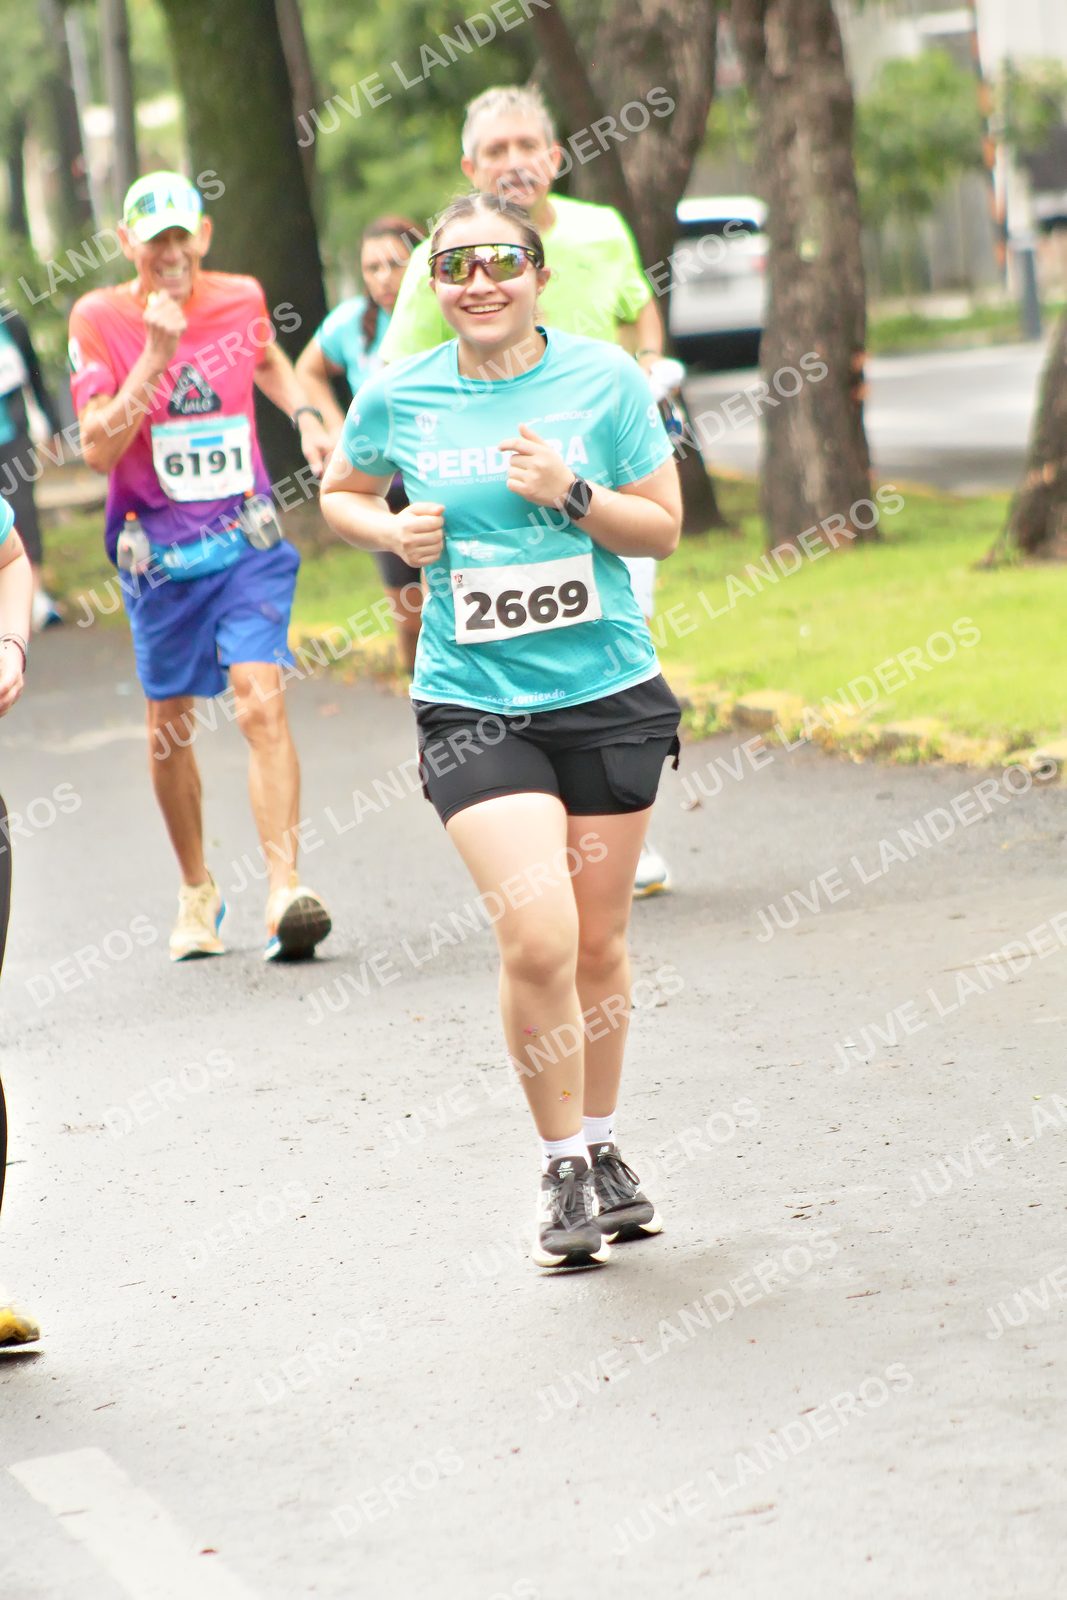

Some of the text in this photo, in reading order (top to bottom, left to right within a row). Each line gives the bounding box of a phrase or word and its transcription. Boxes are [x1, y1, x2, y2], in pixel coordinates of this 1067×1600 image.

[164, 447, 243, 476] 6191
[416, 435, 588, 480] PERDA
[463, 580, 589, 630] 2669
